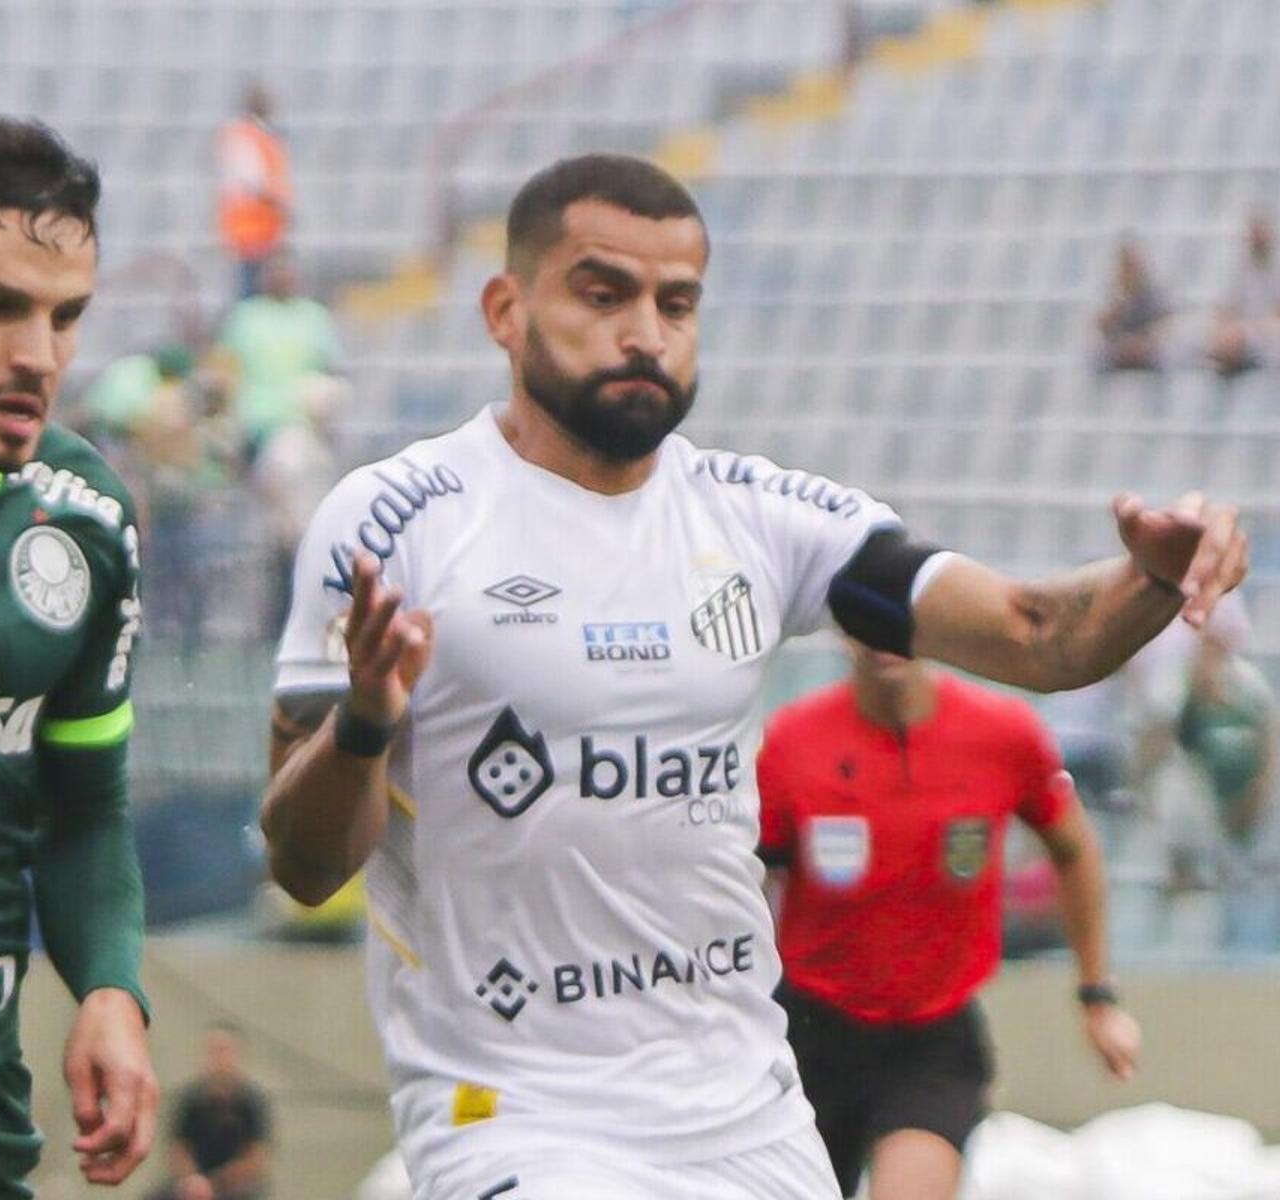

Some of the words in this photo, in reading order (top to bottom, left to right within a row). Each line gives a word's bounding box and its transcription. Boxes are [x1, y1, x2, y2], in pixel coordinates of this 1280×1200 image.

[7, 461, 122, 527] refisa
[322, 457, 463, 597] Kcaldo
[494, 609, 558, 625] umbro
[587, 645, 671, 661] BOND
[580, 735, 739, 799] blaze
[554, 934, 755, 1002] BINANCE
